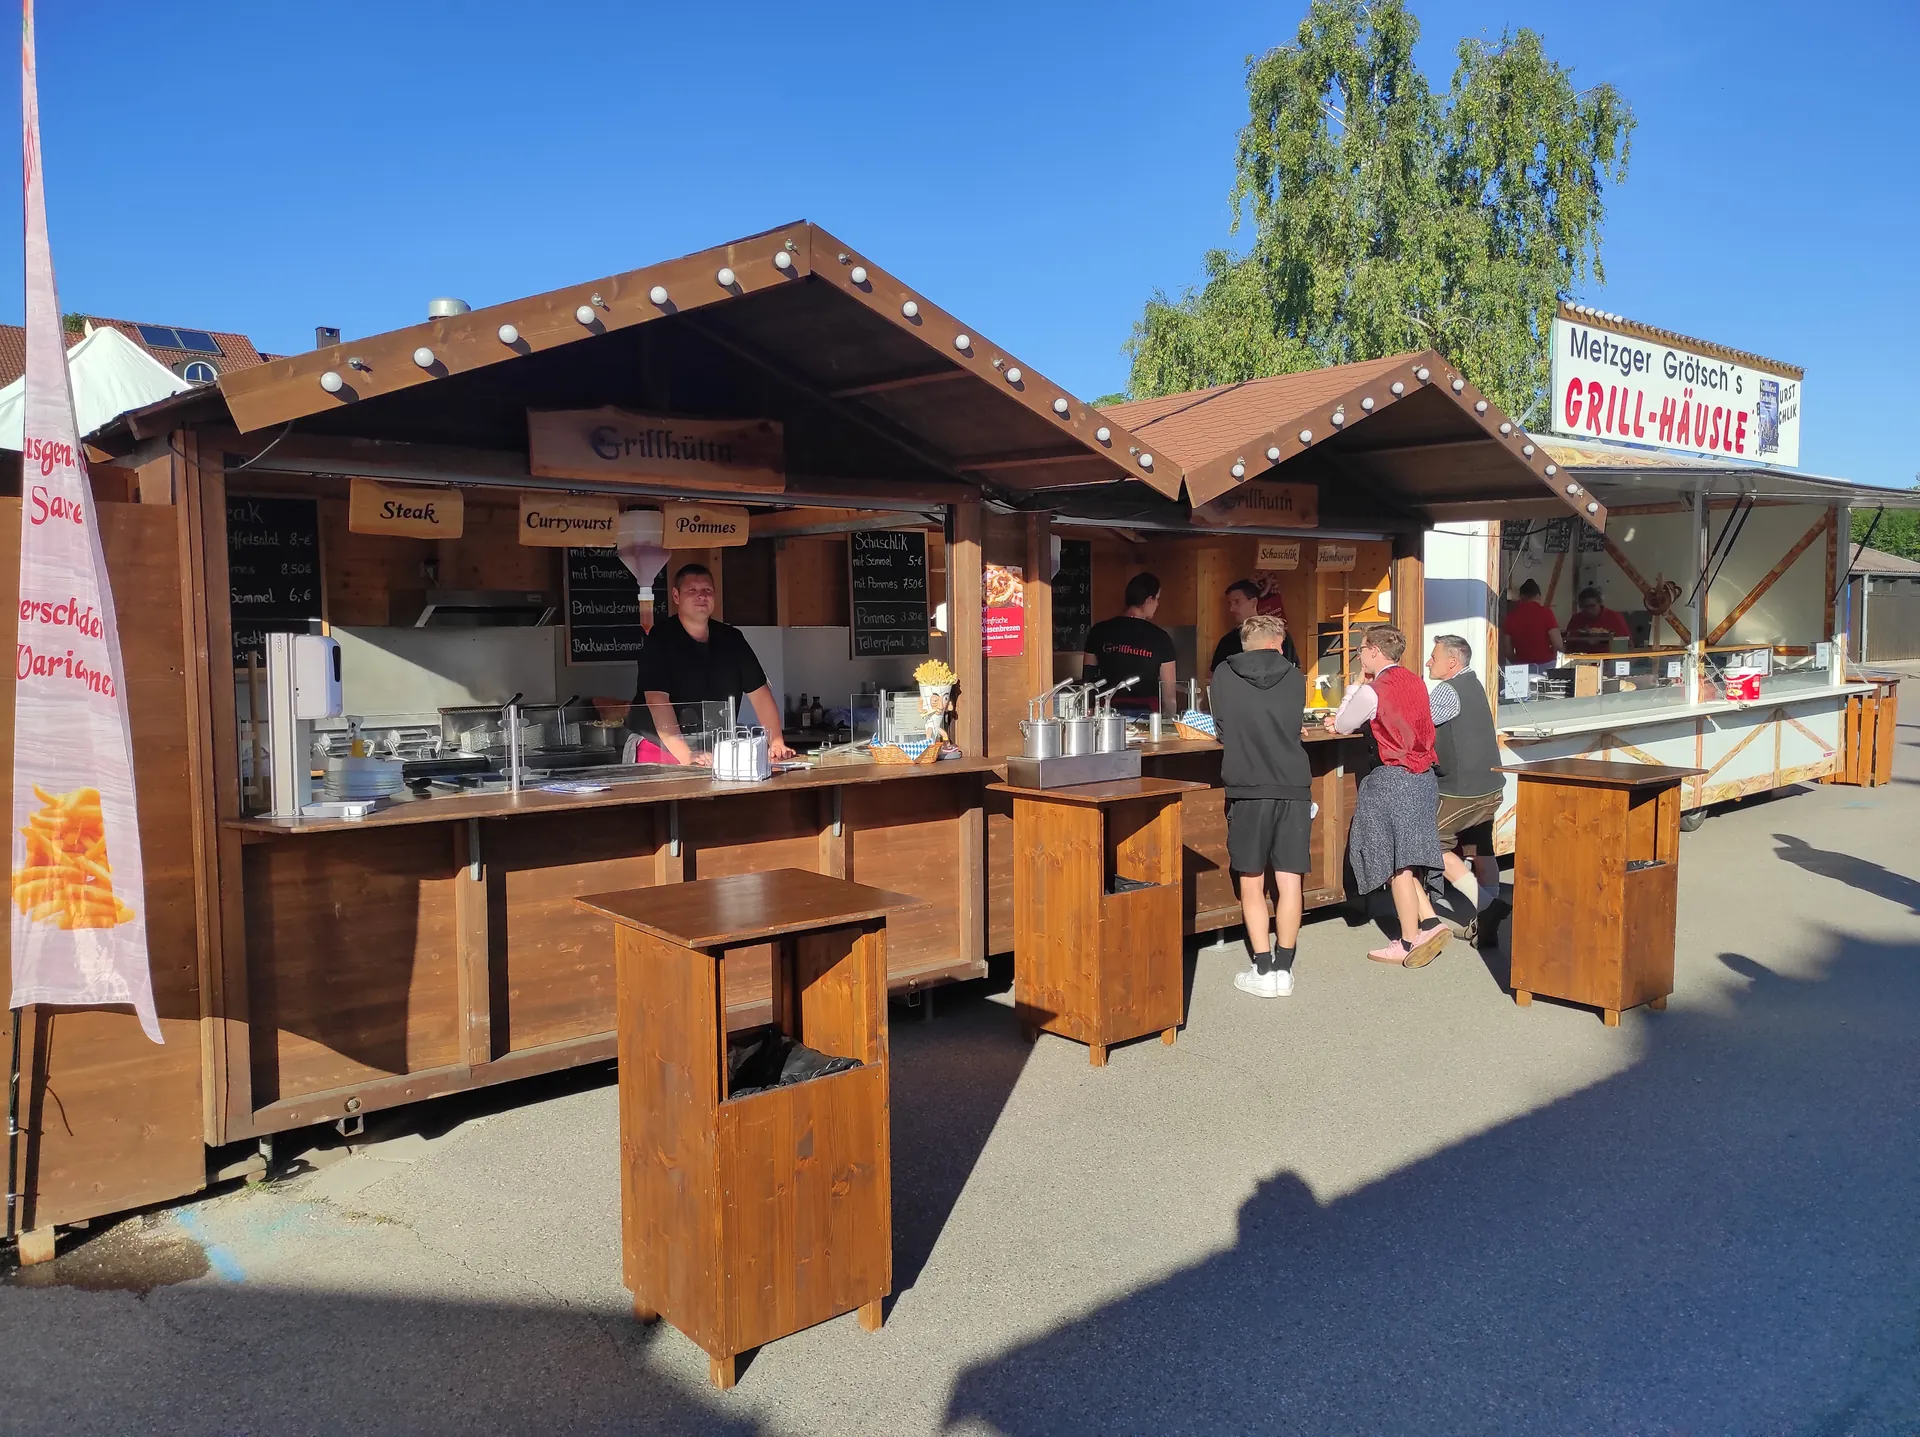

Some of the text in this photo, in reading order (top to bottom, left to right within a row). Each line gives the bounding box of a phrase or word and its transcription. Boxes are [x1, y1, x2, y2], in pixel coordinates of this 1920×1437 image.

[1570, 327, 1651, 377] Metzger
[1779, 384, 1796, 404] URST
[1565, 377, 1748, 454] GRILL-HÄUSLE
[1779, 404, 1797, 425] CHLIK
[379, 501, 440, 524] Steak
[526, 512, 613, 533] Currywurst
[675, 516, 737, 534] Pommes
[853, 554, 865, 567] mit
[1260, 548, 1298, 562] Schaschlik
[1318, 552, 1355, 565] Hamburger
[572, 565, 630, 579] mit Pommes
[854, 576, 865, 589] mit
[868, 577, 898, 590] Pommes
[856, 606, 896, 626] Pommes
